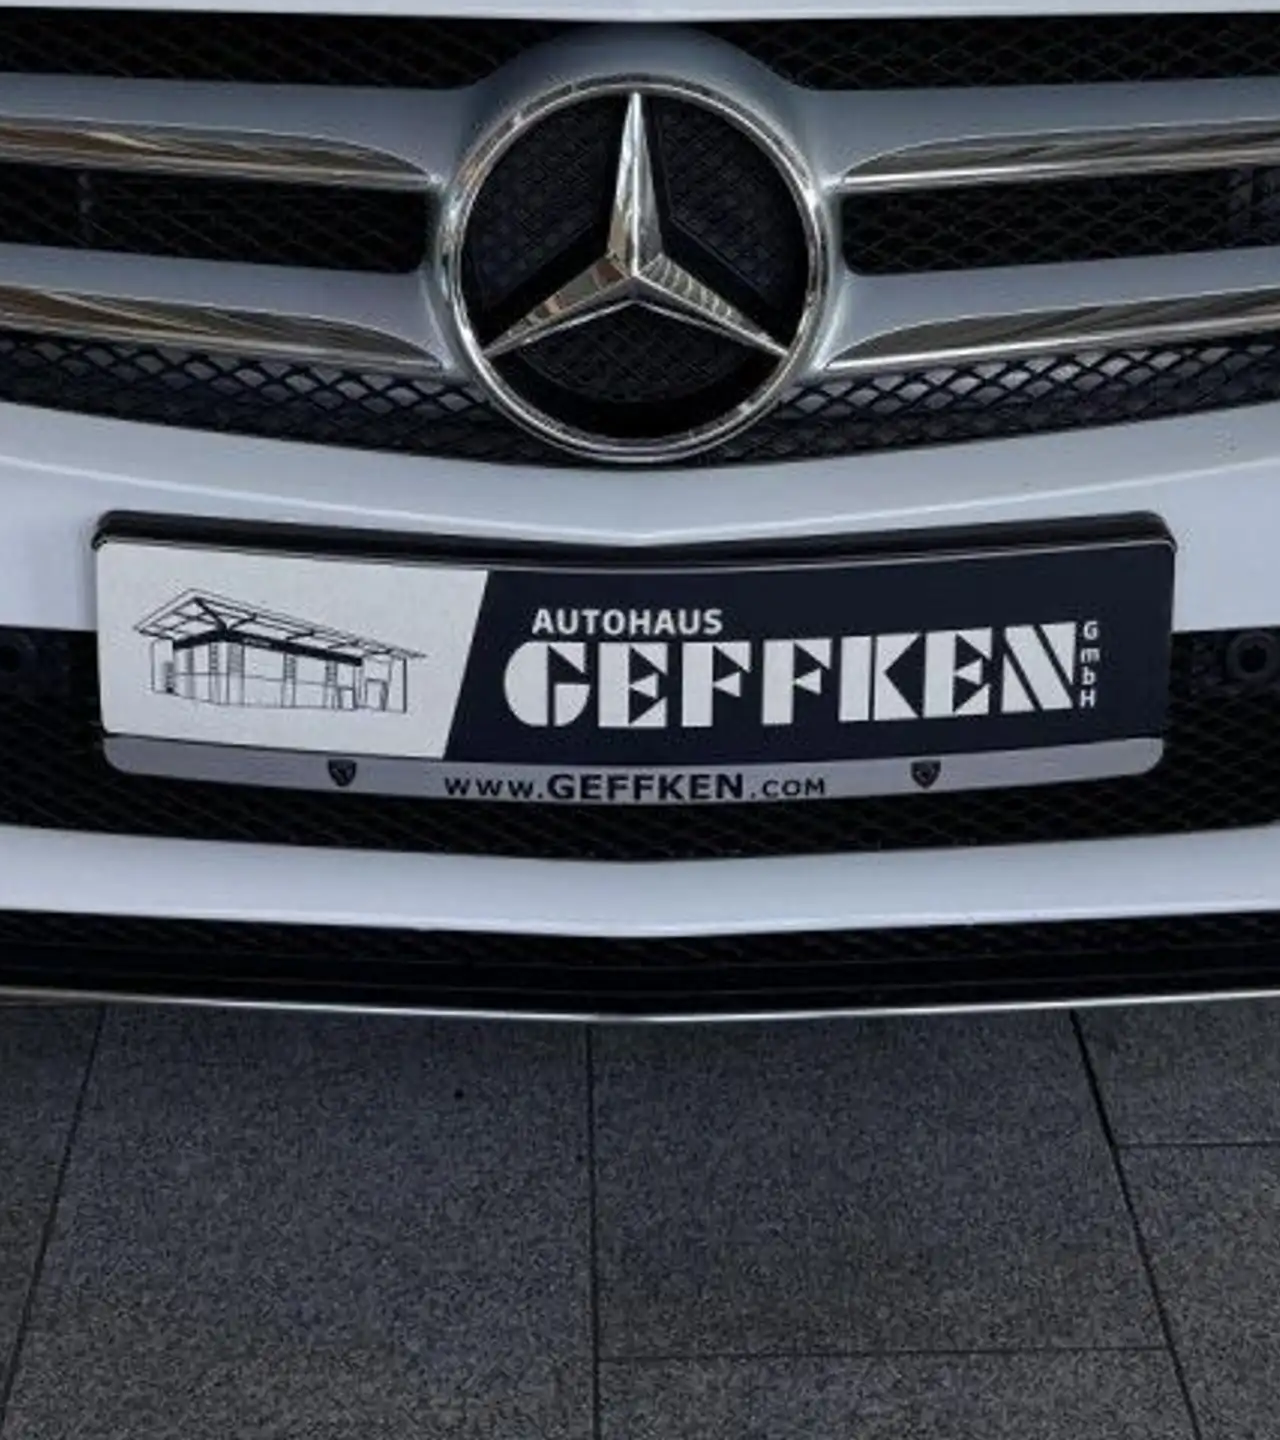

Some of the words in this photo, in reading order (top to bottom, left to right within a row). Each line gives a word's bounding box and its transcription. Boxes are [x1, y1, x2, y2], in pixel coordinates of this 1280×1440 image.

[532, 608, 723, 636] AUTOHAUS
[1080, 620, 1101, 709] GmbH
[503, 622, 1076, 728] GEFFKEN
